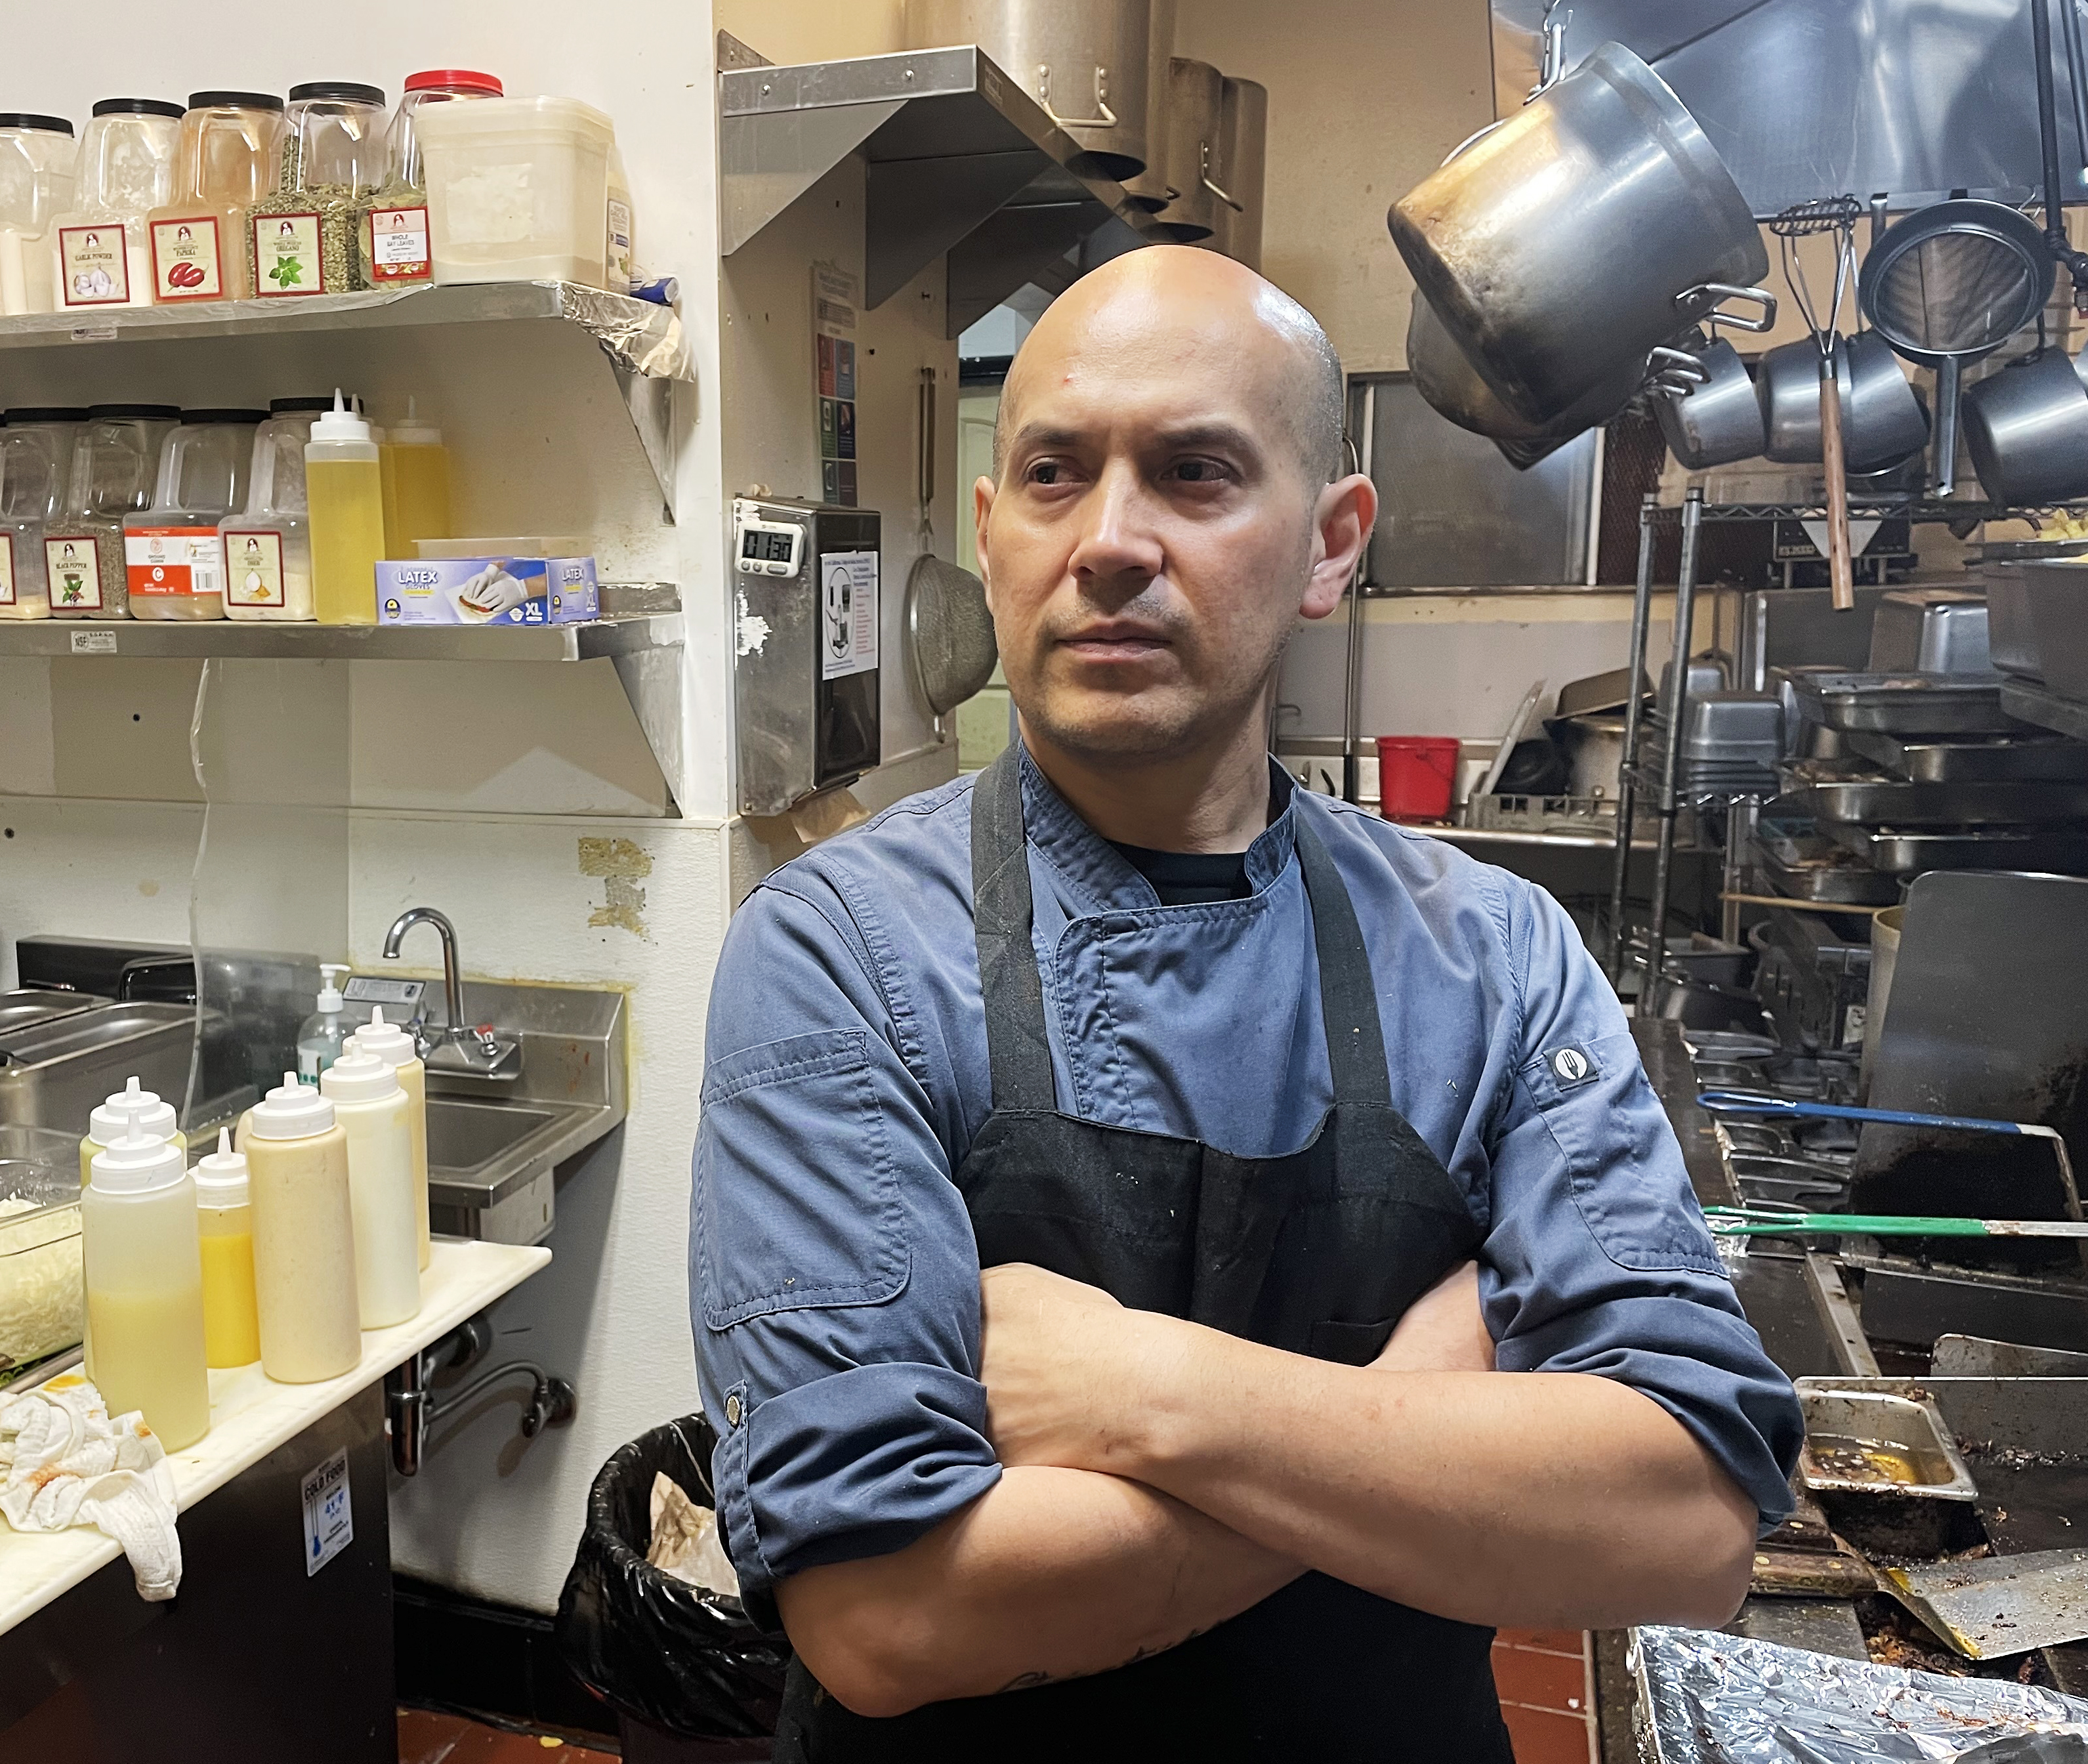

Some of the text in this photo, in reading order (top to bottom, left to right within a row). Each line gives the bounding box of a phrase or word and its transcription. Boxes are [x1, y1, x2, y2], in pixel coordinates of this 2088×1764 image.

[398, 571, 438, 584] LATEX
[561, 568, 585, 582] LATEX
[524, 602, 543, 617] XL
[304, 1476, 325, 1501] COLD
[325, 1460, 346, 1483] FOOD
